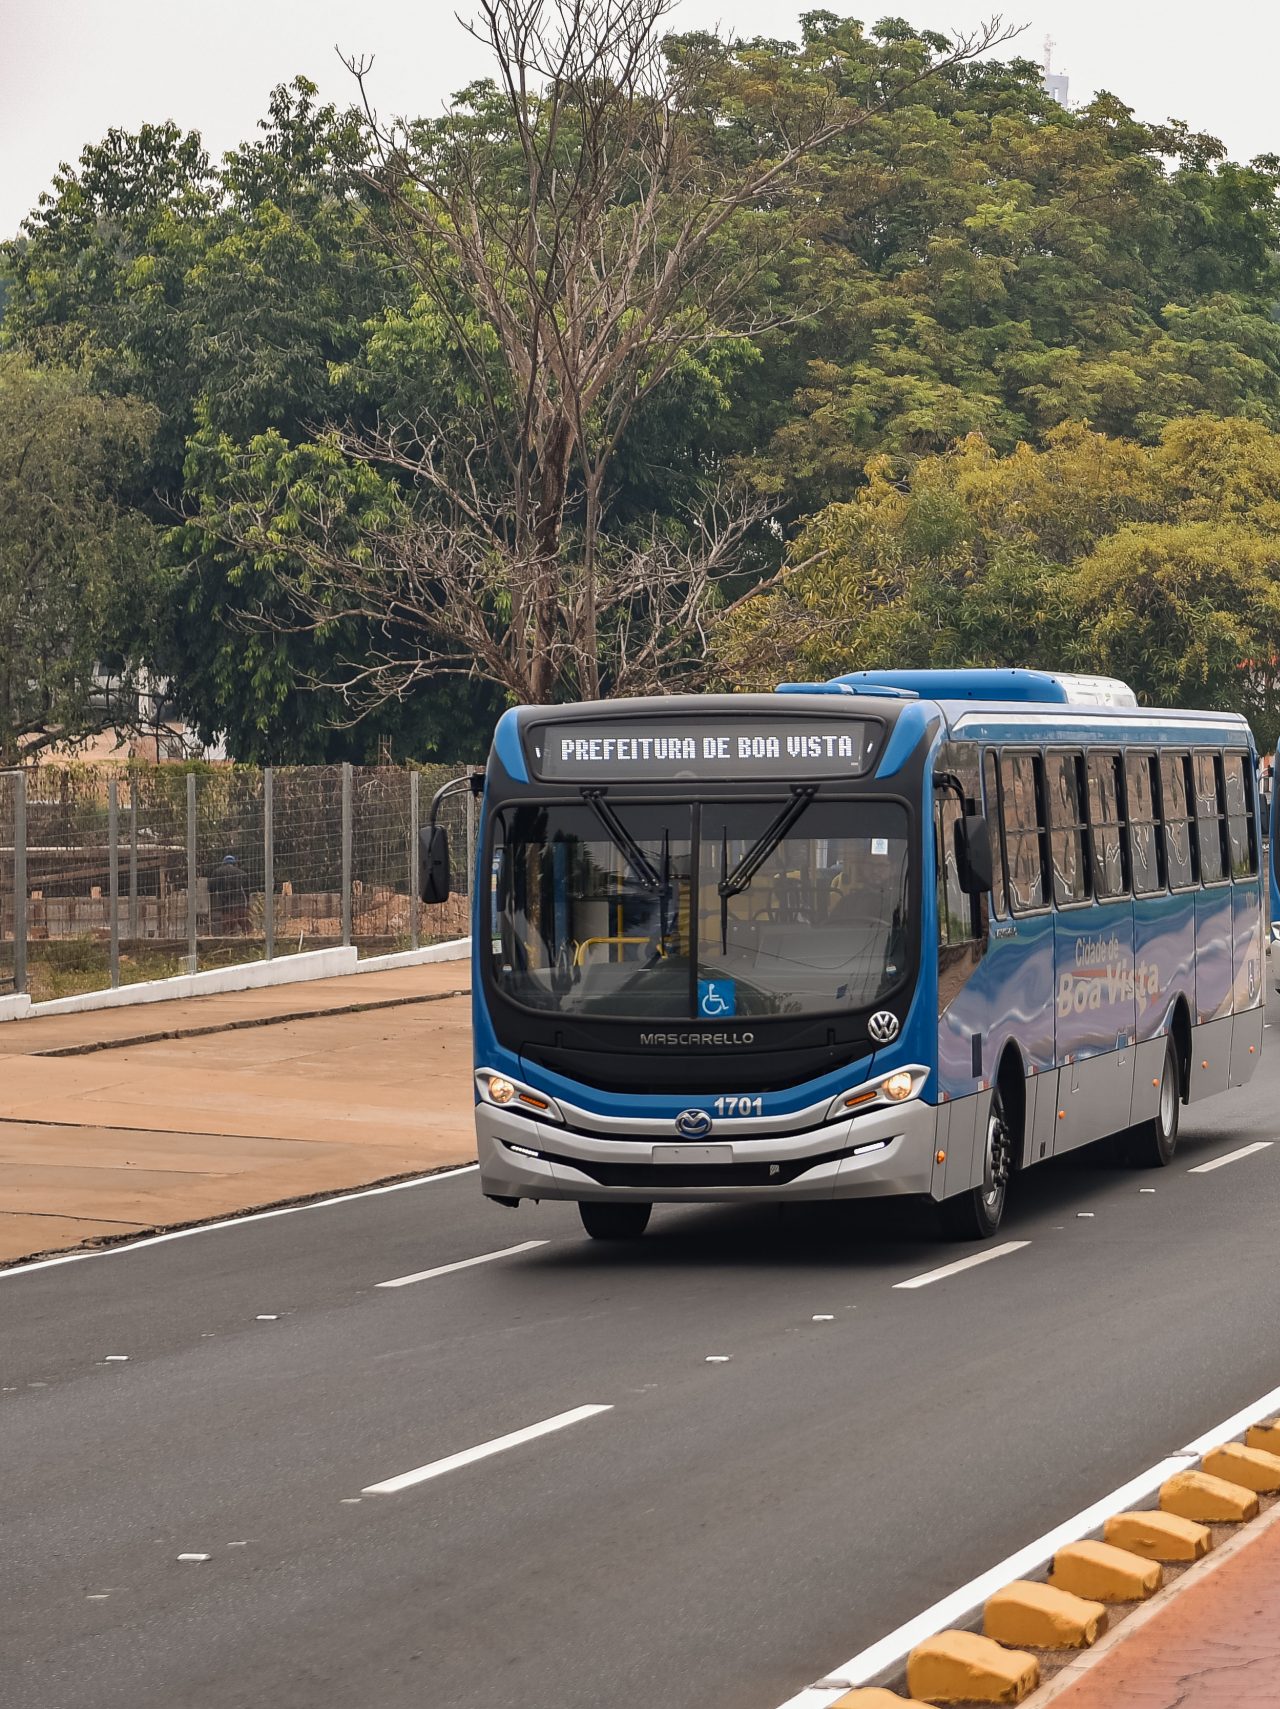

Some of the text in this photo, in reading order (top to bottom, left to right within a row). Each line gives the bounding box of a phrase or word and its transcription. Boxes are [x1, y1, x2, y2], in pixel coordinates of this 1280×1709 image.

[561, 735, 852, 760] PREFEITURA DE BOA VISTA
[1077, 932, 1119, 967] Cidade de
[1057, 959, 1159, 1018] Boa Vista
[640, 1032, 754, 1045] MASCARELLO
[713, 1097, 763, 1116] 1701
